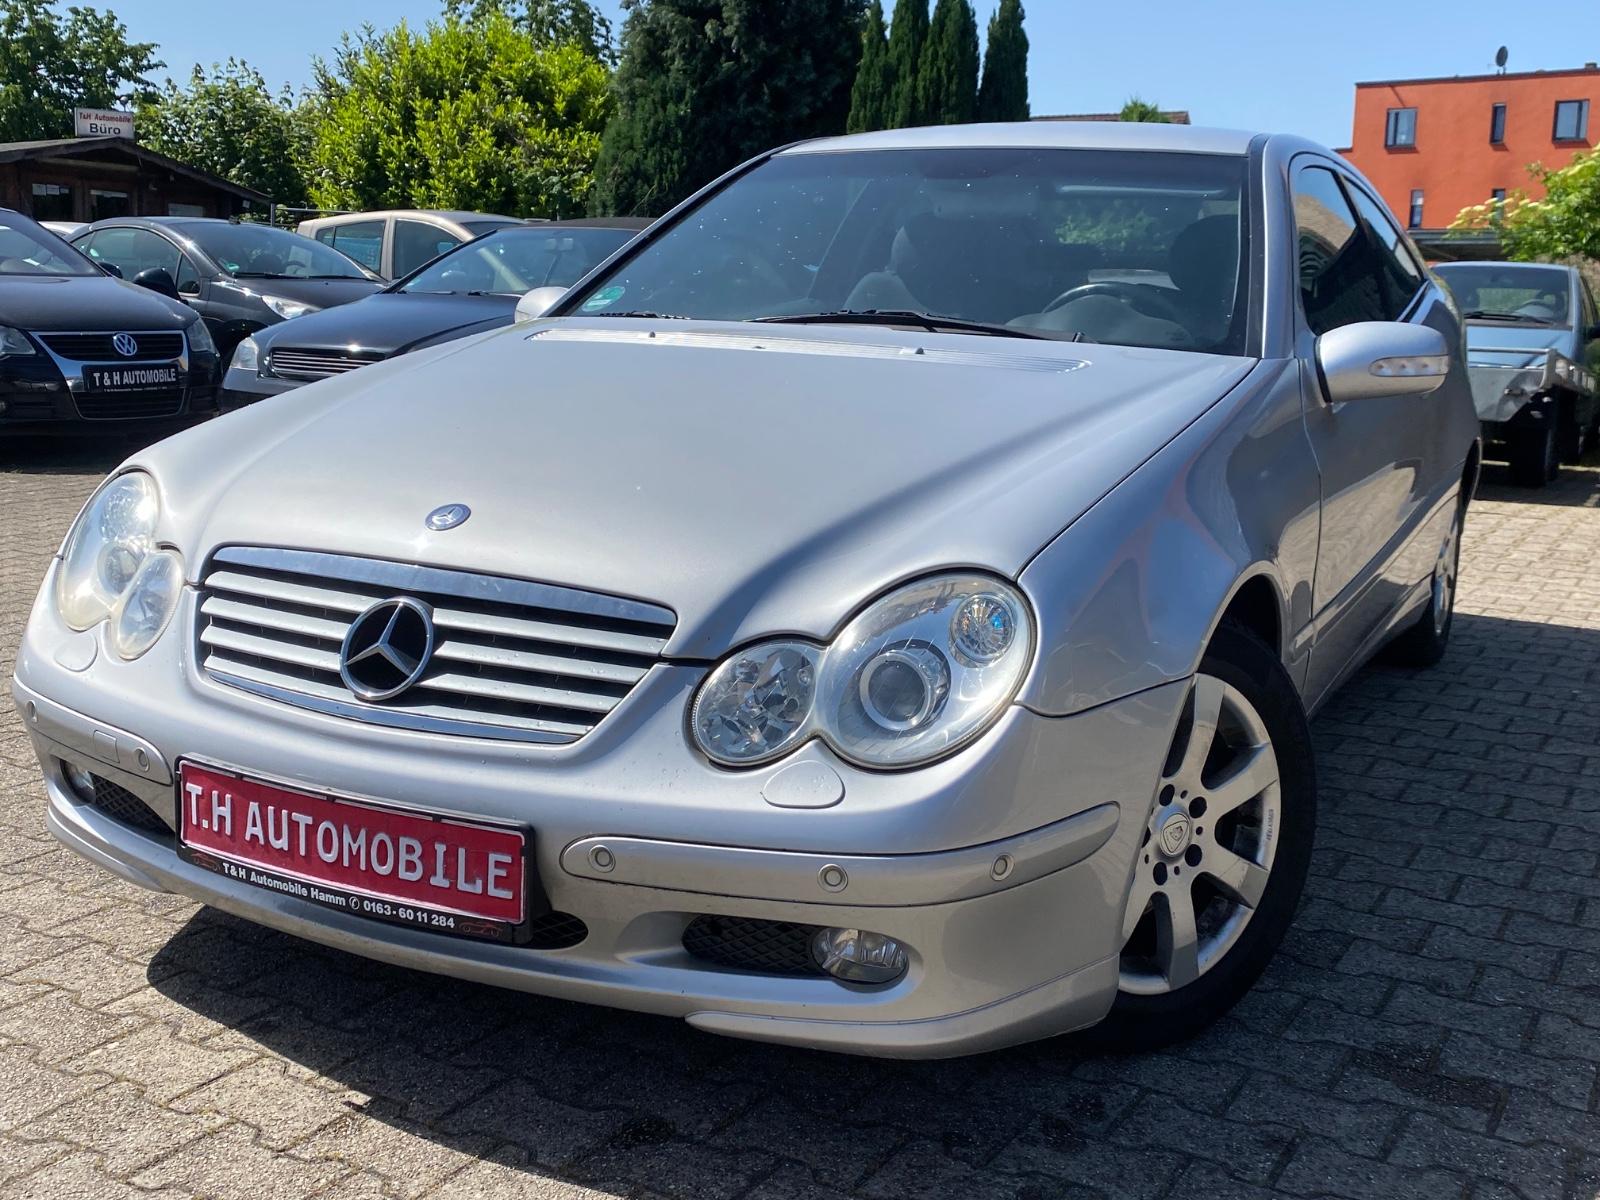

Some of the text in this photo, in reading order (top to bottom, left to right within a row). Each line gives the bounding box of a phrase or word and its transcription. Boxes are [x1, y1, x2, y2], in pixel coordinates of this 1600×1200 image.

[95, 113, 131, 123] Automobile
[89, 123, 121, 135] Büro
[93, 372, 101, 386] T
[103, 371, 111, 386] &
[113, 371, 121, 386] H
[185, 782, 514, 900] T.H AUTOMOBILE
[249, 871, 308, 897] Automobile
[310, 887, 346, 906] Hamm
[431, 914, 455, 929] 284
